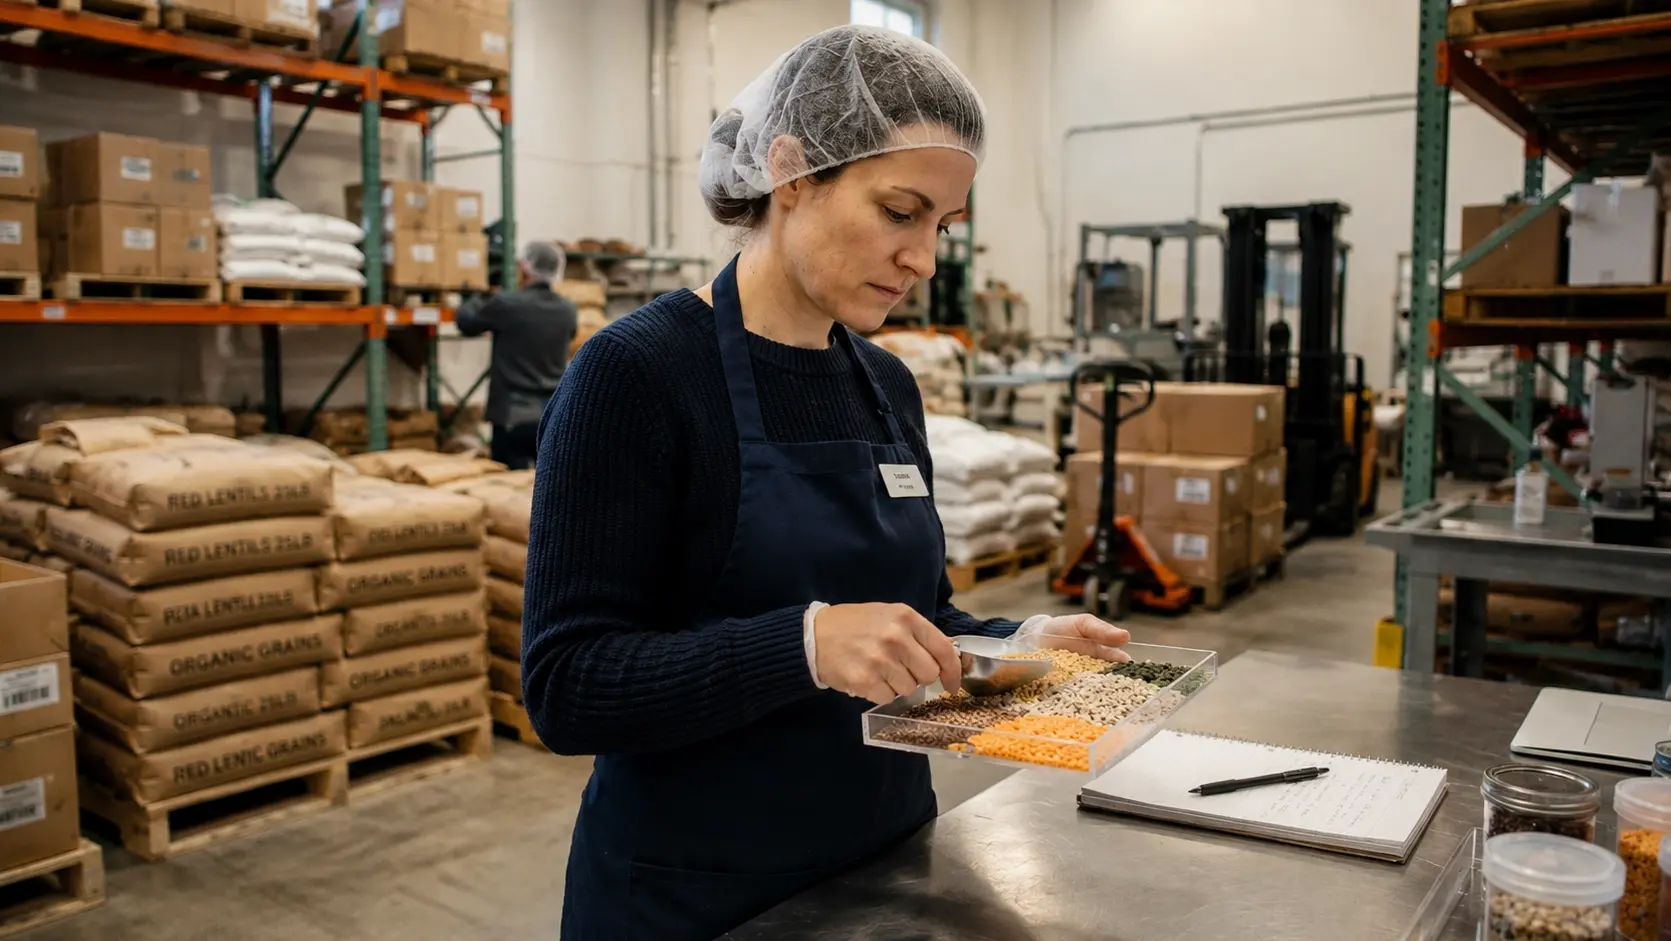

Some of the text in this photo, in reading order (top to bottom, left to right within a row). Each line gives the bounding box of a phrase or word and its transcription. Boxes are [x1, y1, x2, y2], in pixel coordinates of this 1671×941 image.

[167, 492, 203, 511] RED
[207, 484, 269, 507] LENTILS
[164, 548, 200, 567] RED
[204, 536, 270, 561] LENTILS
[169, 633, 322, 676] ORGANIC GRAINS
[173, 759, 210, 784] RED
[267, 733, 327, 757] GRAINS
